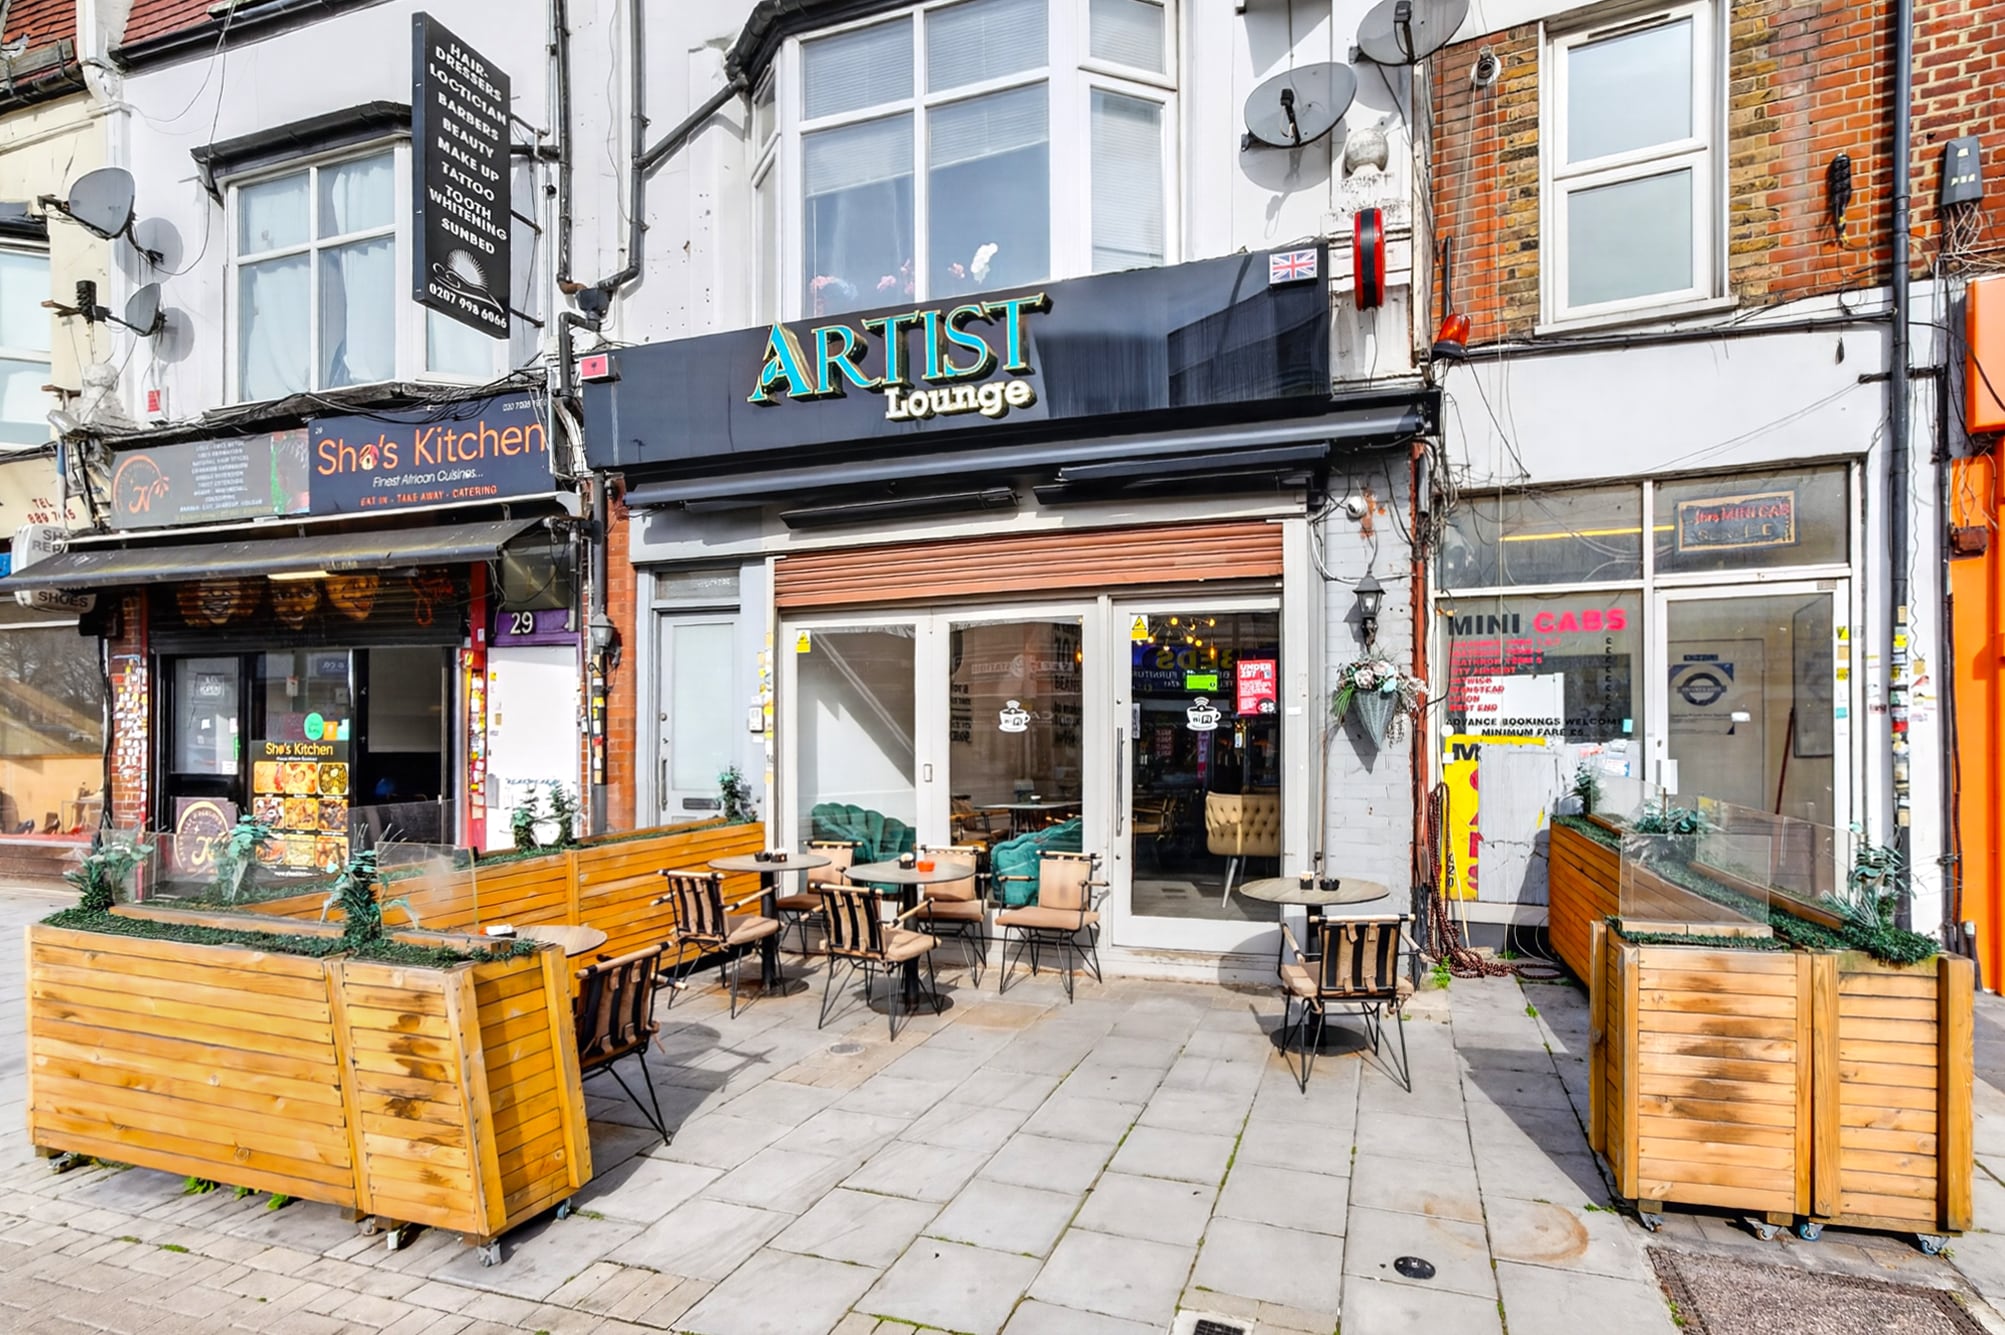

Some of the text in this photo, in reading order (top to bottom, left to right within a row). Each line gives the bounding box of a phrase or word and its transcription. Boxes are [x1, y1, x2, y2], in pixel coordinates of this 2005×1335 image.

[435, 45, 502, 102] DRESSERS
[450, 43, 489, 79] HAIR-
[429, 62, 507, 126] LOCTICIAN
[437, 91, 499, 141] BARBERS
[442, 117, 494, 158] BEAUTY
[437, 135, 500, 182] MAKE UP
[440, 161, 495, 202] TATTOO
[428, 186, 508, 241] WHITENING
[444, 184, 492, 221] TOOTH
[440, 217, 495, 254] SUNBED
[428, 283, 457, 304] 0207
[480, 307, 508, 329] 6066
[747, 292, 1050, 405] ARTIST
[885, 380, 1037, 420] Lounge
[414, 420, 546, 467] Kitchen
[360, 496, 376, 507] EAT
[396, 492, 418, 503] TAKE
[420, 490, 445, 501] AWAY
[452, 484, 498, 498] CATERING
[372, 475, 401, 488] Finest
[401, 472, 436, 485] African
[38, 590, 89, 608] SHOES
[510, 611, 534, 635] 29
[1448, 608, 1628, 636] MINI CABS
[1446, 717, 1497, 726] ADVANCE
[1502, 717, 1561, 726] BOOKINGS
[1481, 728, 1534, 738] MINIMUM
[1537, 728, 1566, 737] FARE
[294, 742, 333, 756] Kitchen
